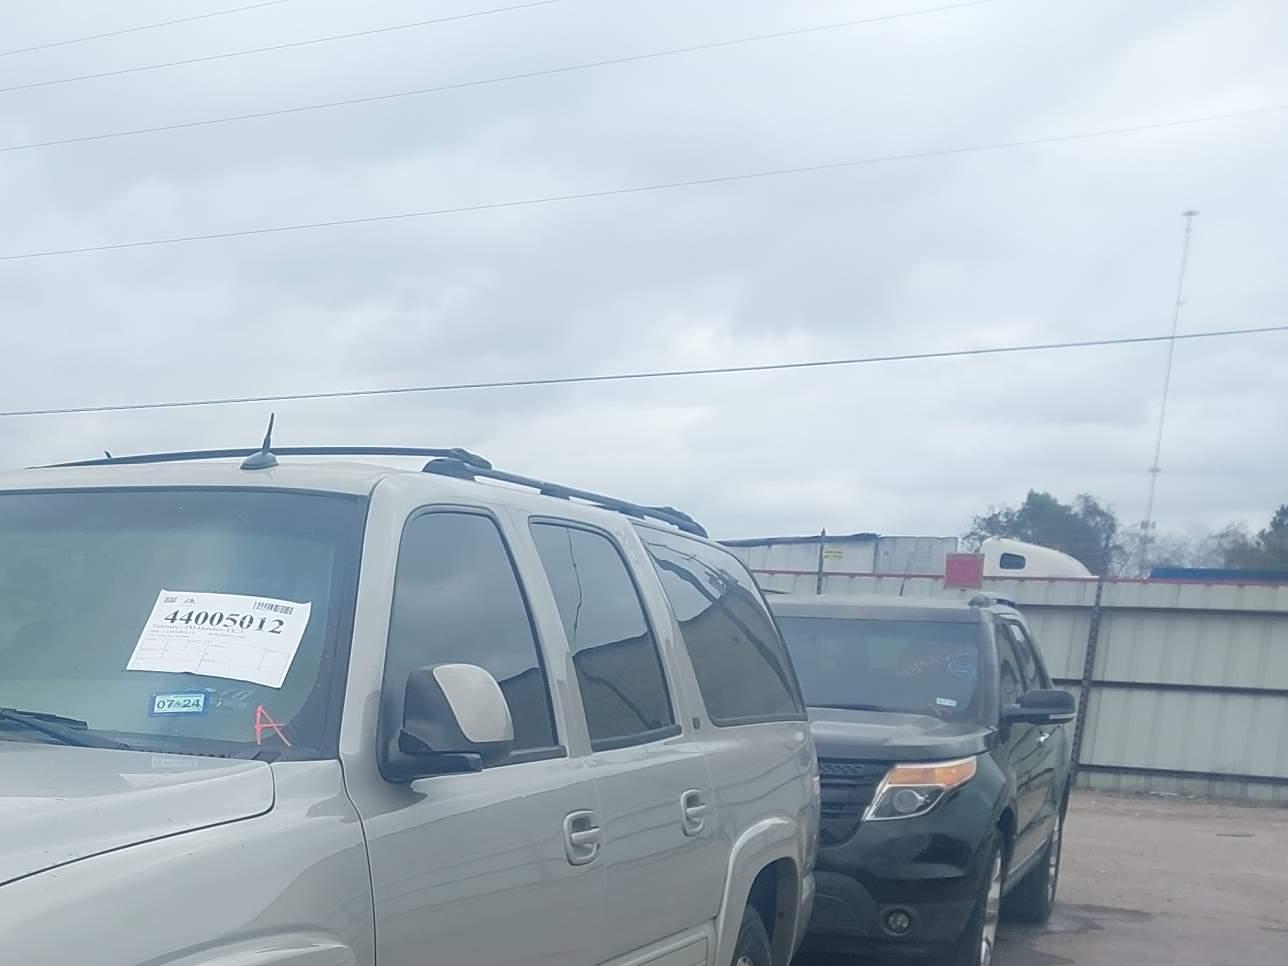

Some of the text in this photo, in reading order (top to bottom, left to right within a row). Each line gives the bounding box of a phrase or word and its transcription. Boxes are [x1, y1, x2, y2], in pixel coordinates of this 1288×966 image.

[164, 609, 285, 635] 44005012
[156, 698, 200, 709] 07 24
[254, 704, 291, 747] A
